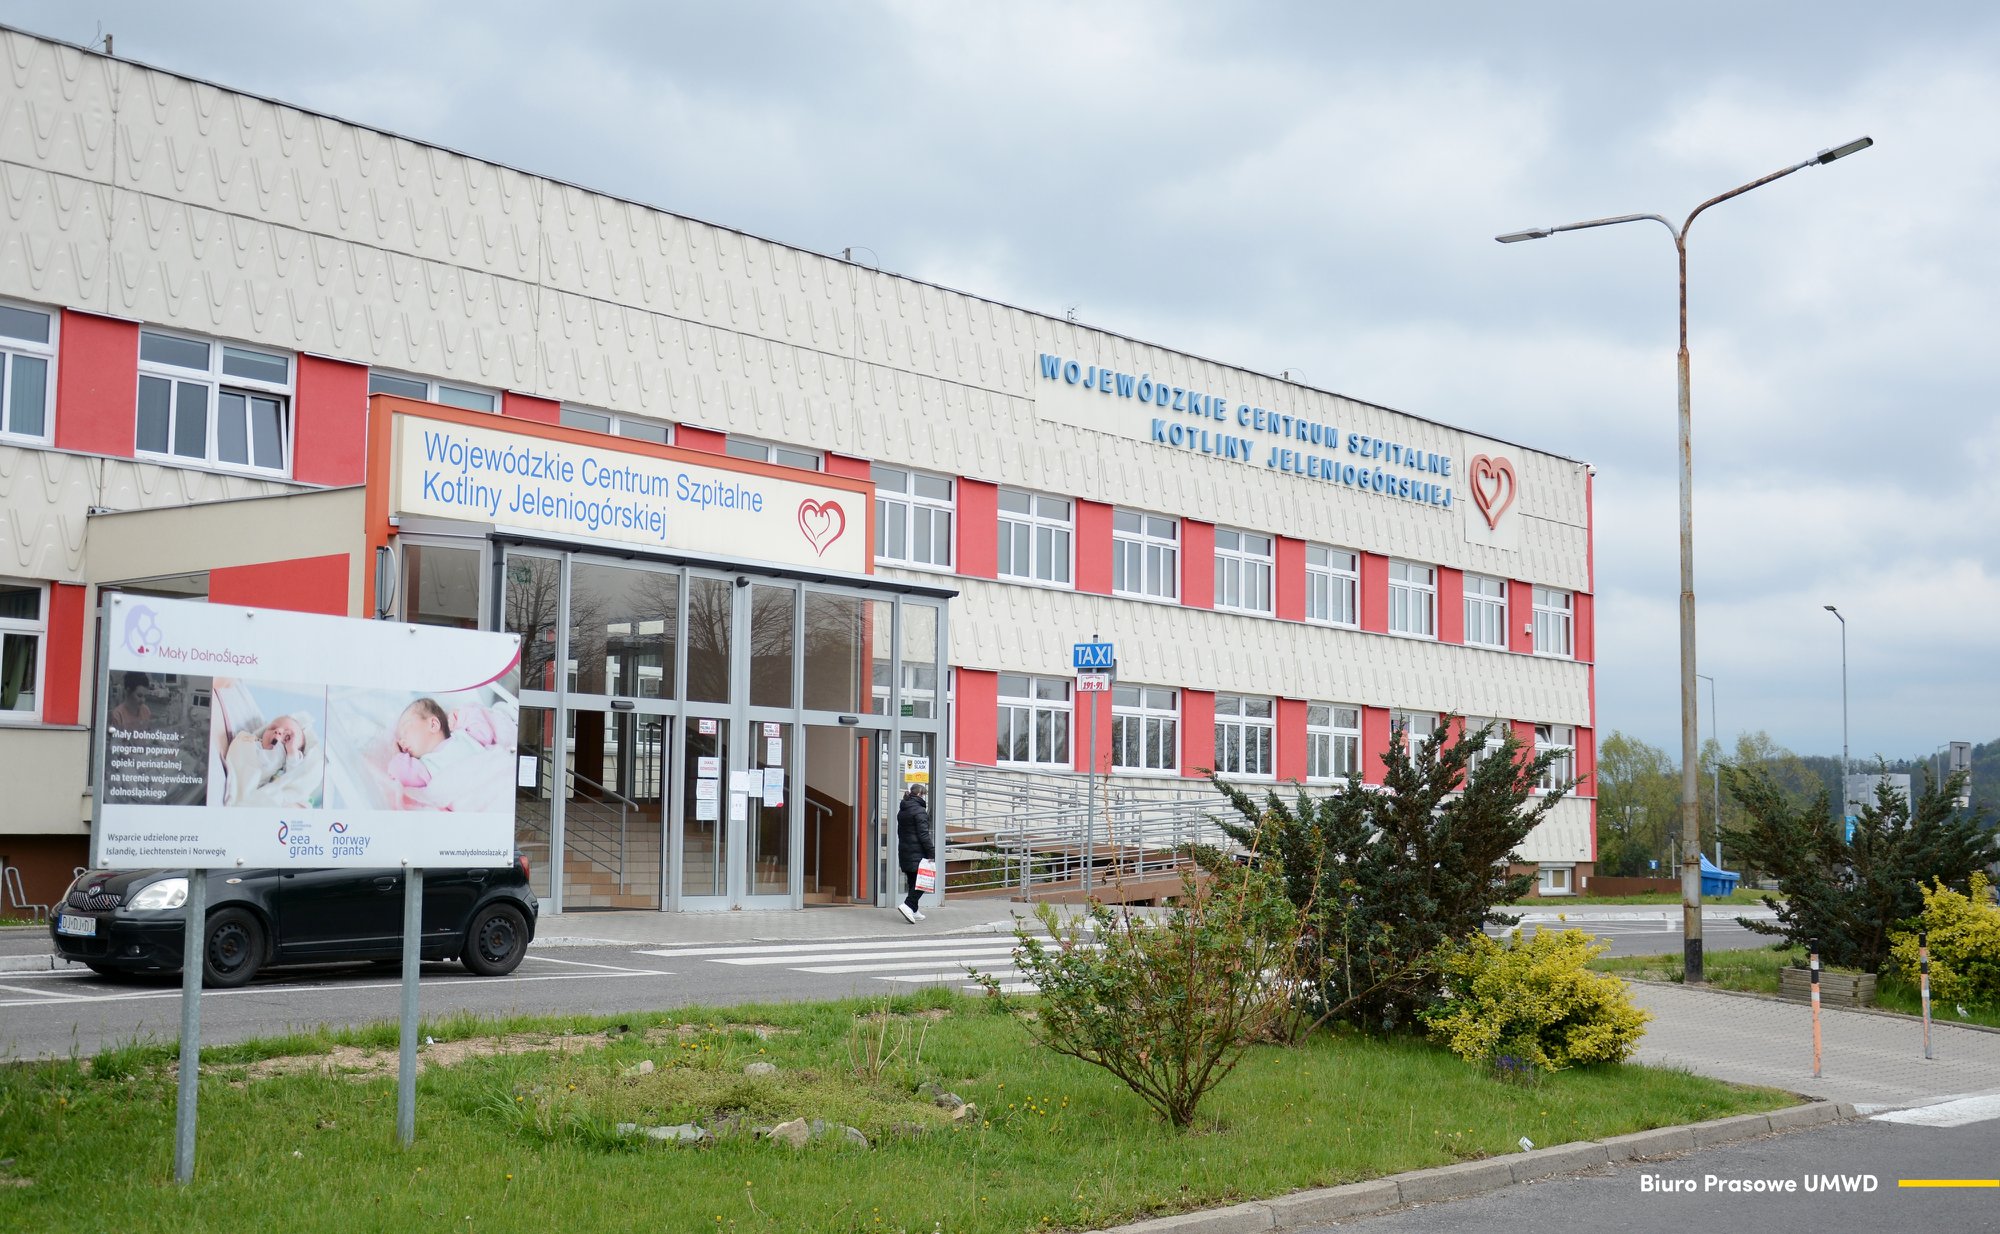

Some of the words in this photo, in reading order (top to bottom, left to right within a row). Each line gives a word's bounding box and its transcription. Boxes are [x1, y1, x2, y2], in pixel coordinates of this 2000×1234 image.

[1040, 353, 1227, 421] WOJEWÓDZKIE
[1237, 404, 1339, 449] CENTRUM
[1347, 432, 1452, 477] SZPITALNE
[1152, 418, 1254, 462] KOTLINY
[1267, 446, 1452, 507] JELENIOGÓRSKIEJ
[424, 431, 574, 483] Wojewódzkie
[581, 457, 669, 498] Centrum
[676, 473, 763, 513] Szpitalne
[423, 470, 502, 517] Kotliny
[509, 484, 667, 541] Jeleniogórskiej
[159, 645, 188, 662] Mały
[191, 648, 258, 666] DolnoŚlązak
[1075, 645, 1112, 665] TAXI
[111, 729, 132, 741] Mały
[111, 744, 145, 755] program
[145, 746, 180, 757] poprawy
[110, 758, 135, 769] opieki
[136, 759, 183, 771] perinatalnej
[110, 774, 121, 782] na
[122, 774, 150, 783] terenie
[151, 774, 203, 785] województwa
[110, 787, 168, 799] dolnośląskiego
[107, 833, 141, 843] Wsparcie
[143, 833, 178, 842] udzielone
[179, 835, 199, 843] przez
[290, 835, 310, 845] eea
[332, 836, 371, 848] norway
[139, 847, 187, 856] Liechtenstein
[192, 847, 226, 856] Norwegię
[289, 845, 324, 858] grants
[332, 846, 364, 858] grants
